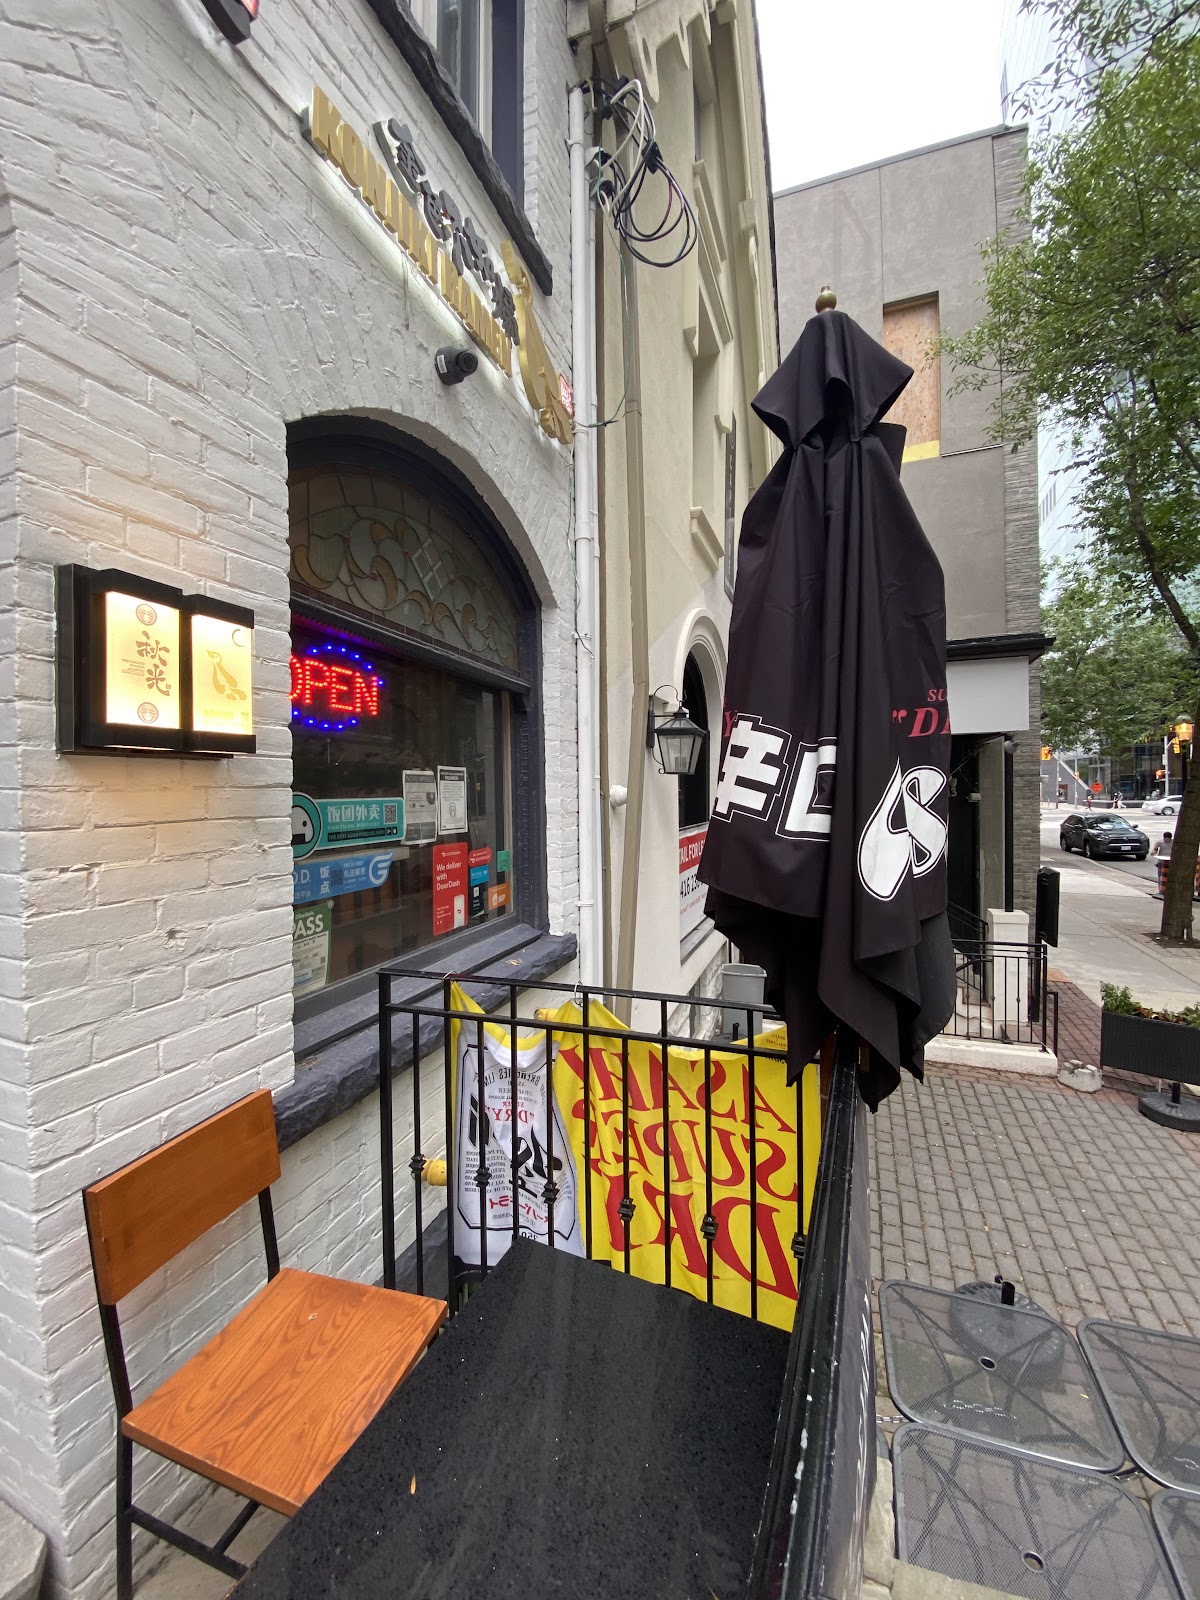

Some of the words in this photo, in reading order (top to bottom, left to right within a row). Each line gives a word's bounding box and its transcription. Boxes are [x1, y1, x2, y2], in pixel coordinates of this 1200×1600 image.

[312, 85, 439, 285] KONJIKI
[438, 246, 514, 378] RAMEN
[327, 803, 381, 823] 饭团外卖
[436, 863, 446, 872] We
[445, 861, 462, 871] deliver
[436, 872, 448, 881] with
[436, 879, 461, 891] DoorDash
